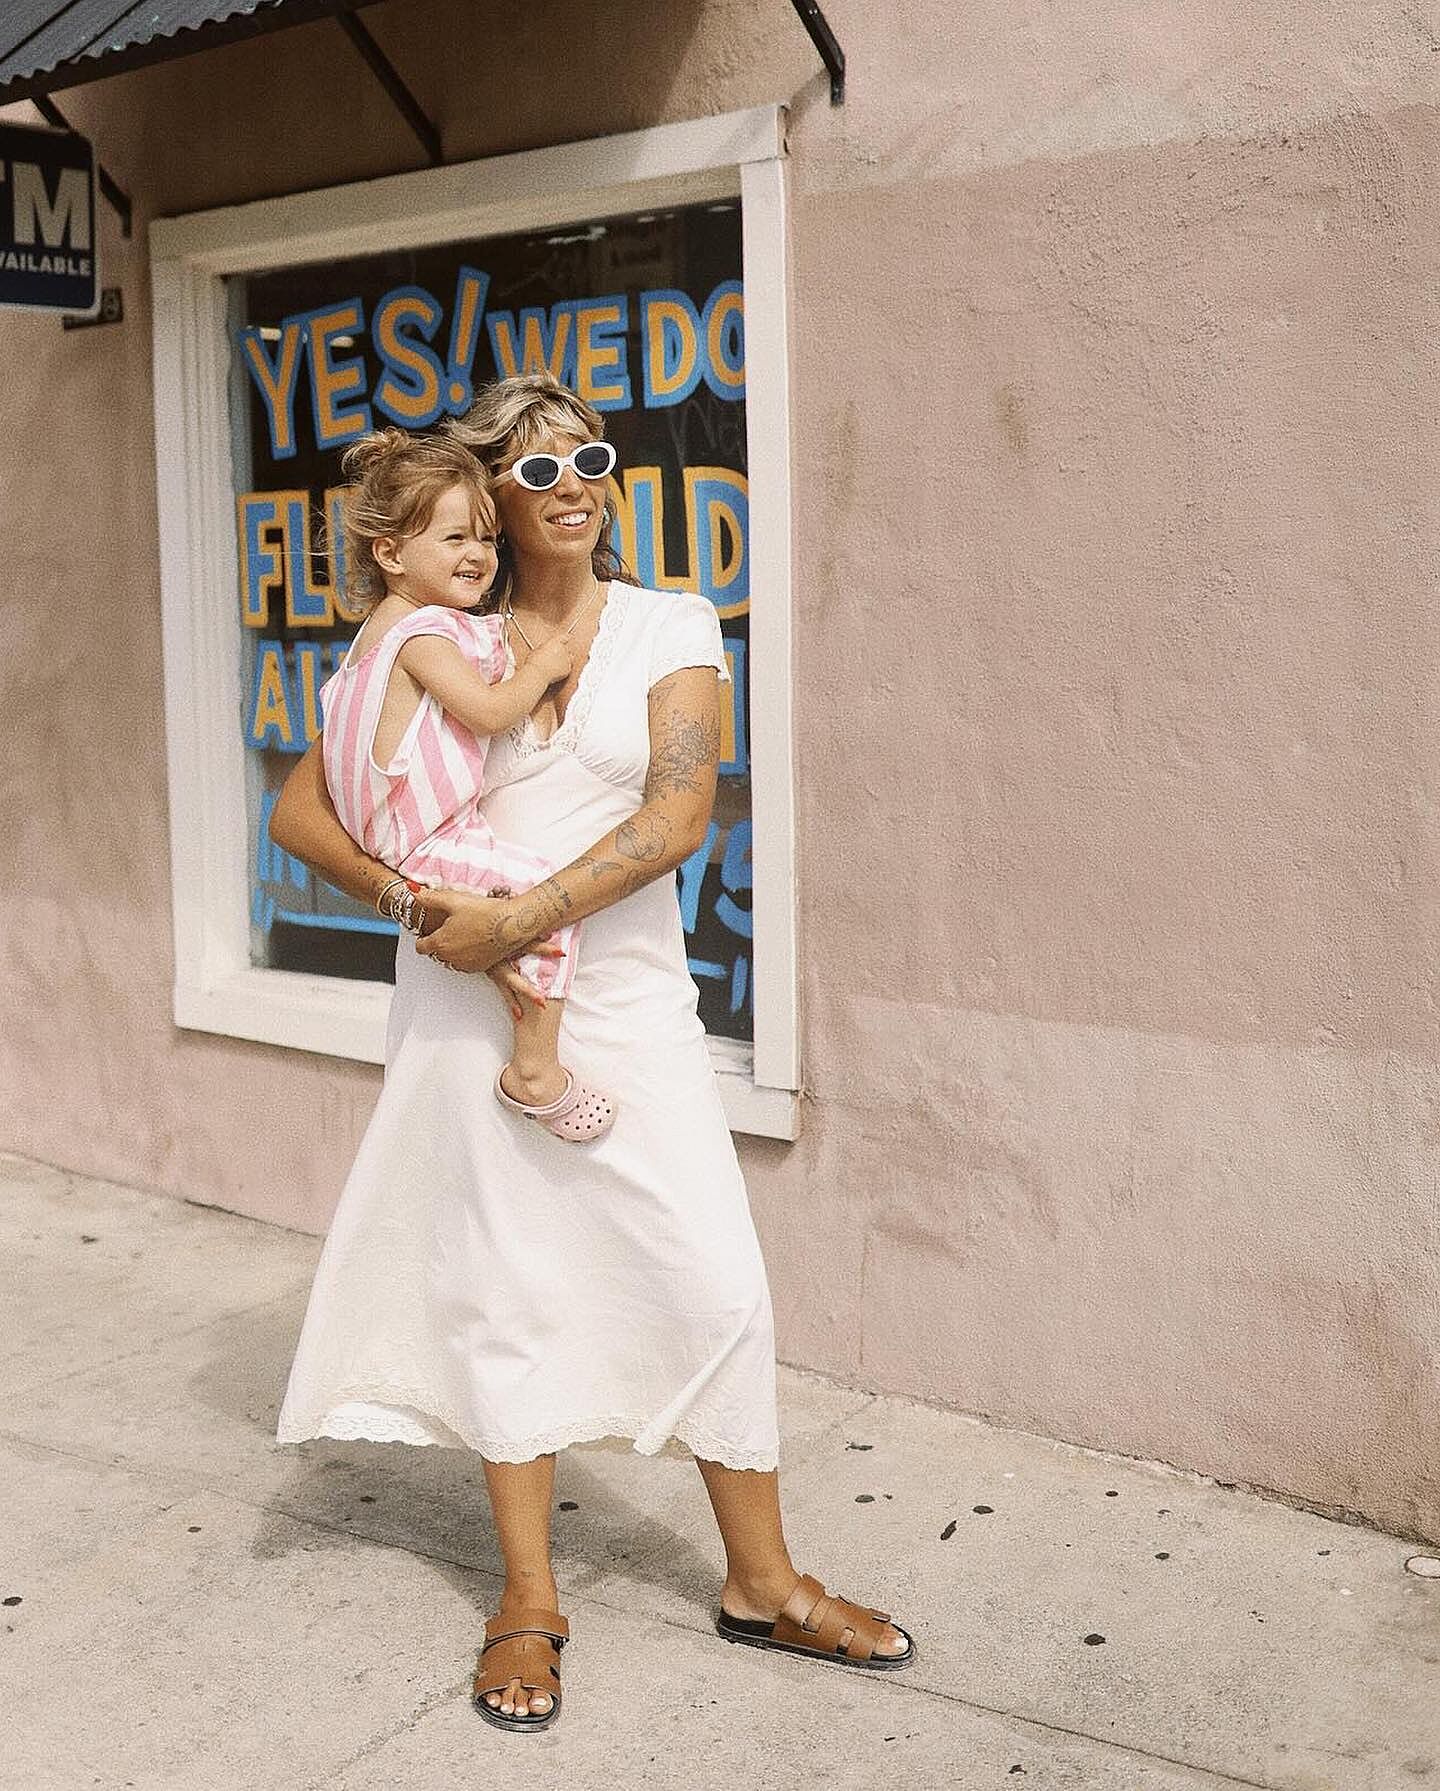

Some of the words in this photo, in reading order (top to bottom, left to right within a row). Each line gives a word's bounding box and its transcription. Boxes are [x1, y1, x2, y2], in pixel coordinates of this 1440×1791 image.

[239, 266, 490, 459] YES!
[486, 294, 632, 410] WE
[641, 280, 747, 410] DO
